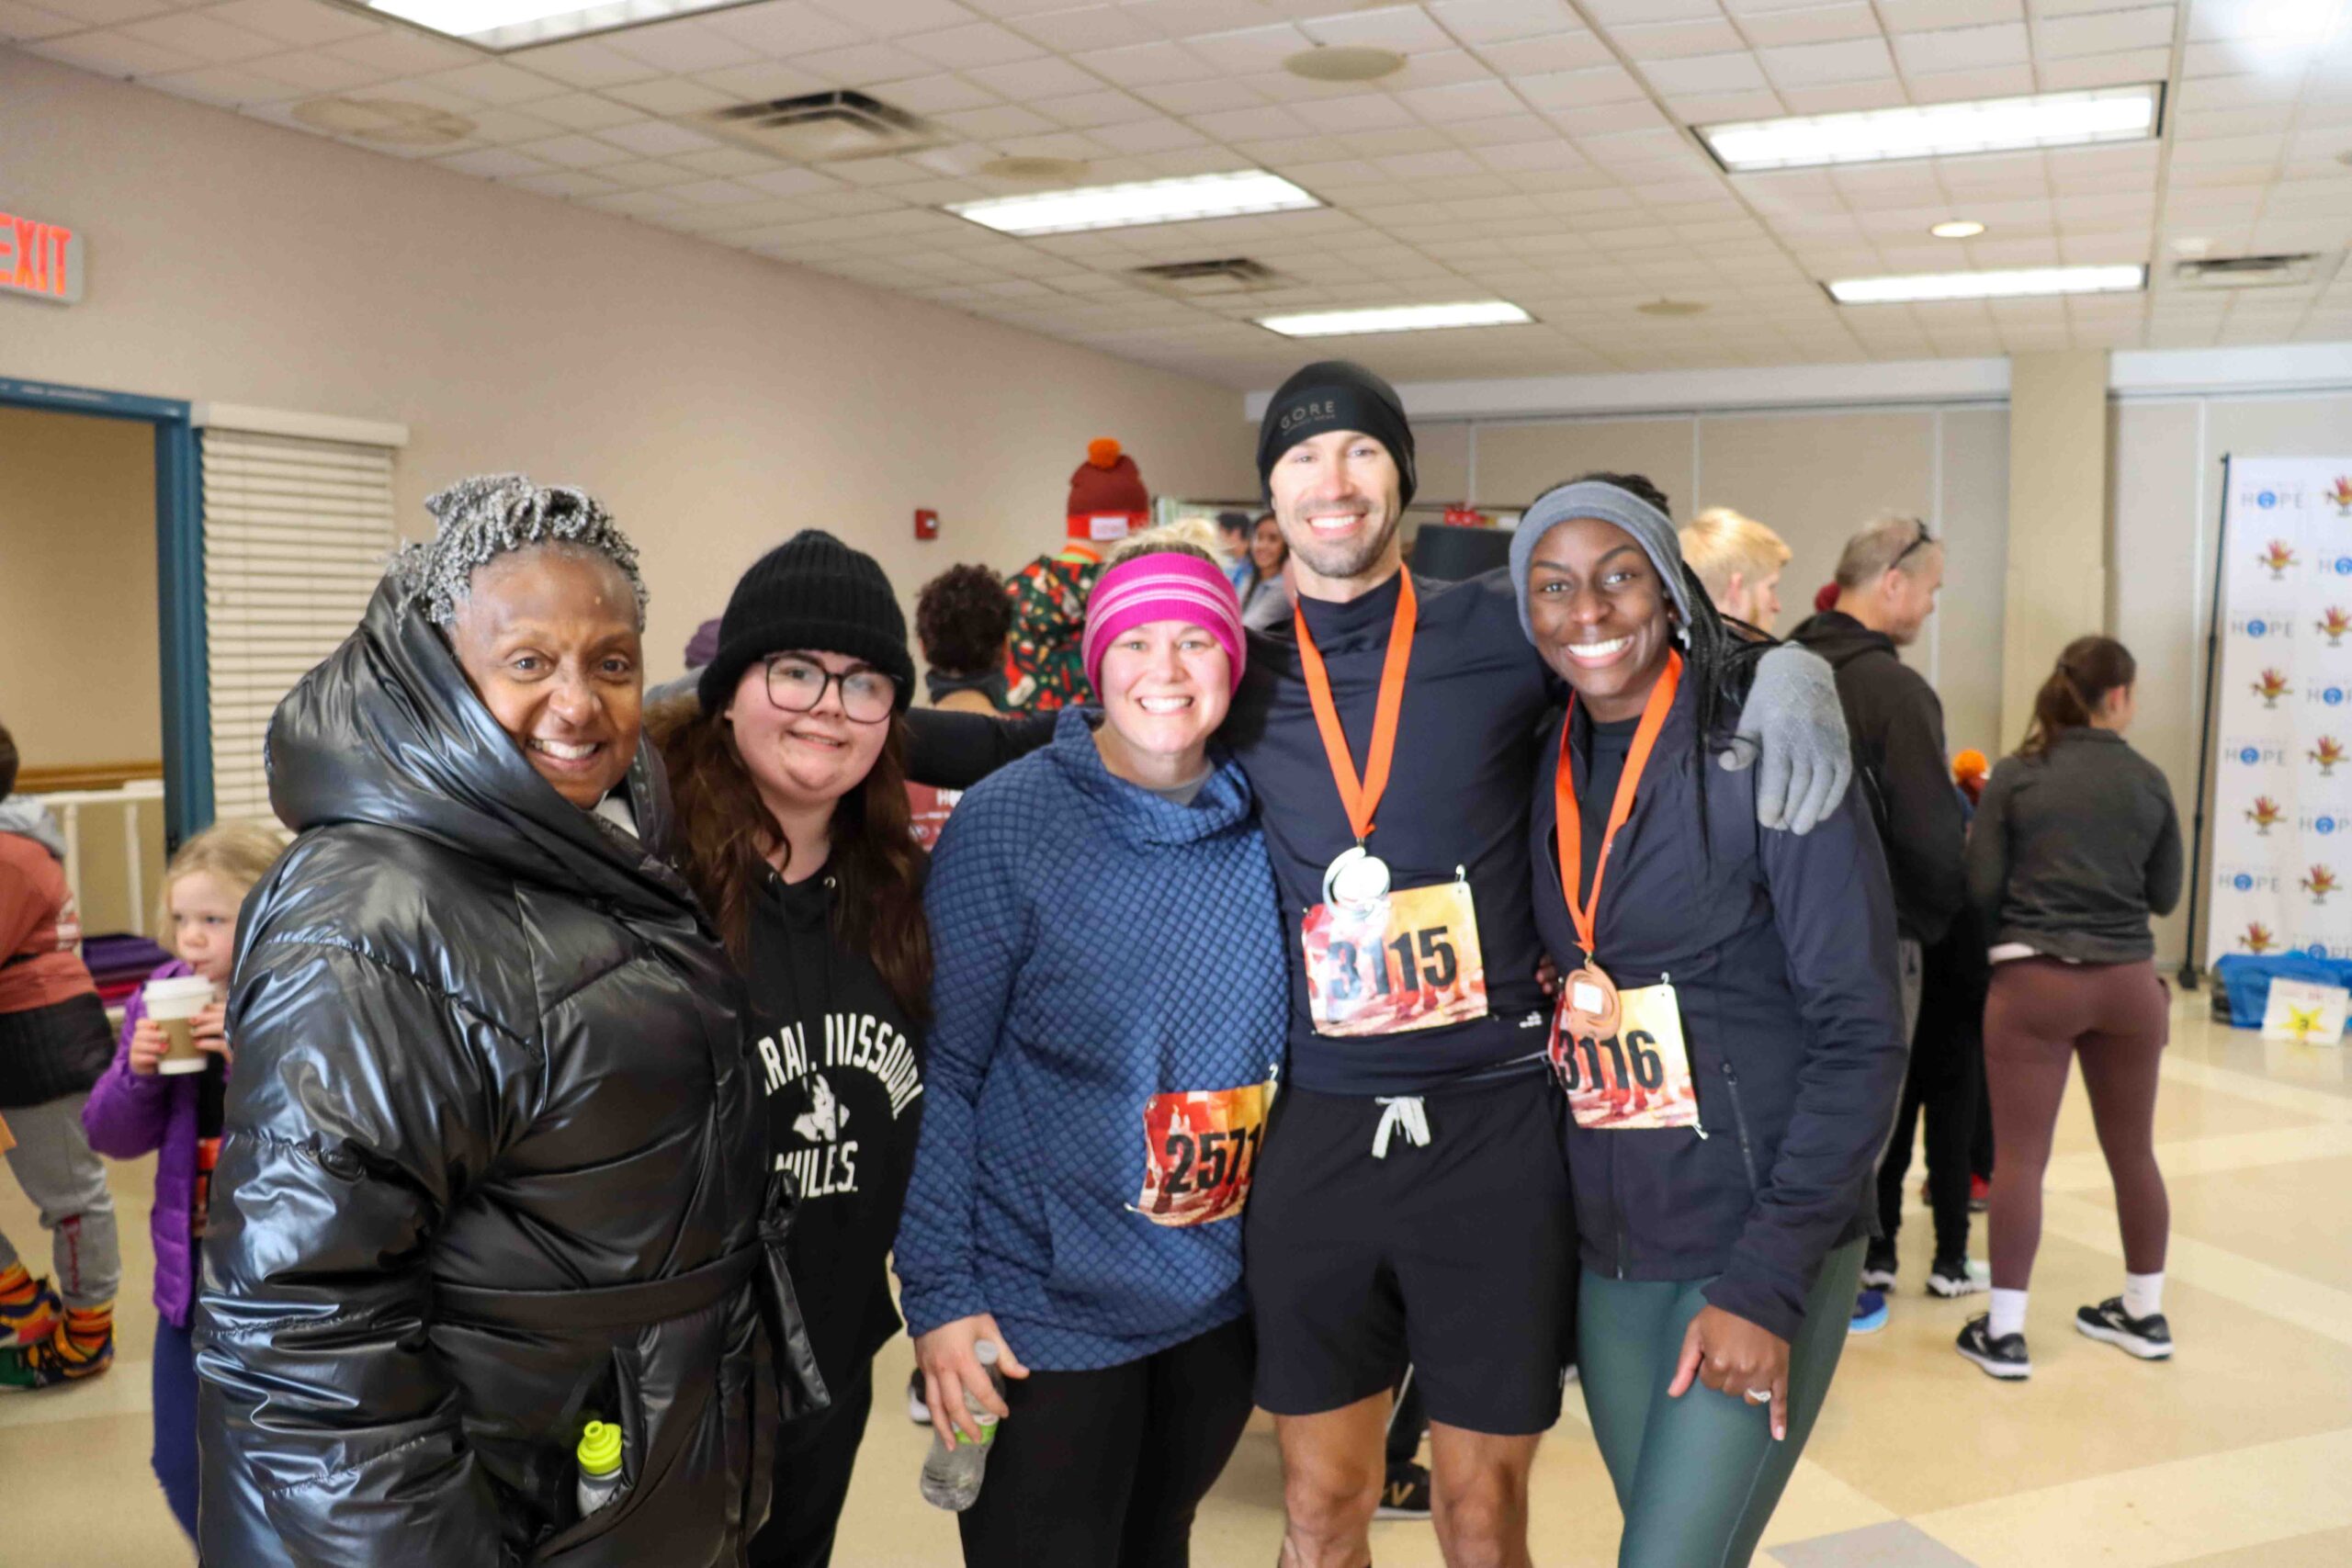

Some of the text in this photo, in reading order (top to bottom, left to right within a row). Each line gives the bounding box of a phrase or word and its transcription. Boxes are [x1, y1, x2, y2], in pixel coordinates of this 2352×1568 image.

[1281, 400, 1335, 430] GORE
[1328, 925, 1458, 1000] 3115
[1558, 1029, 1665, 1090] 3116
[1165, 1122, 1261, 1194] 2571
